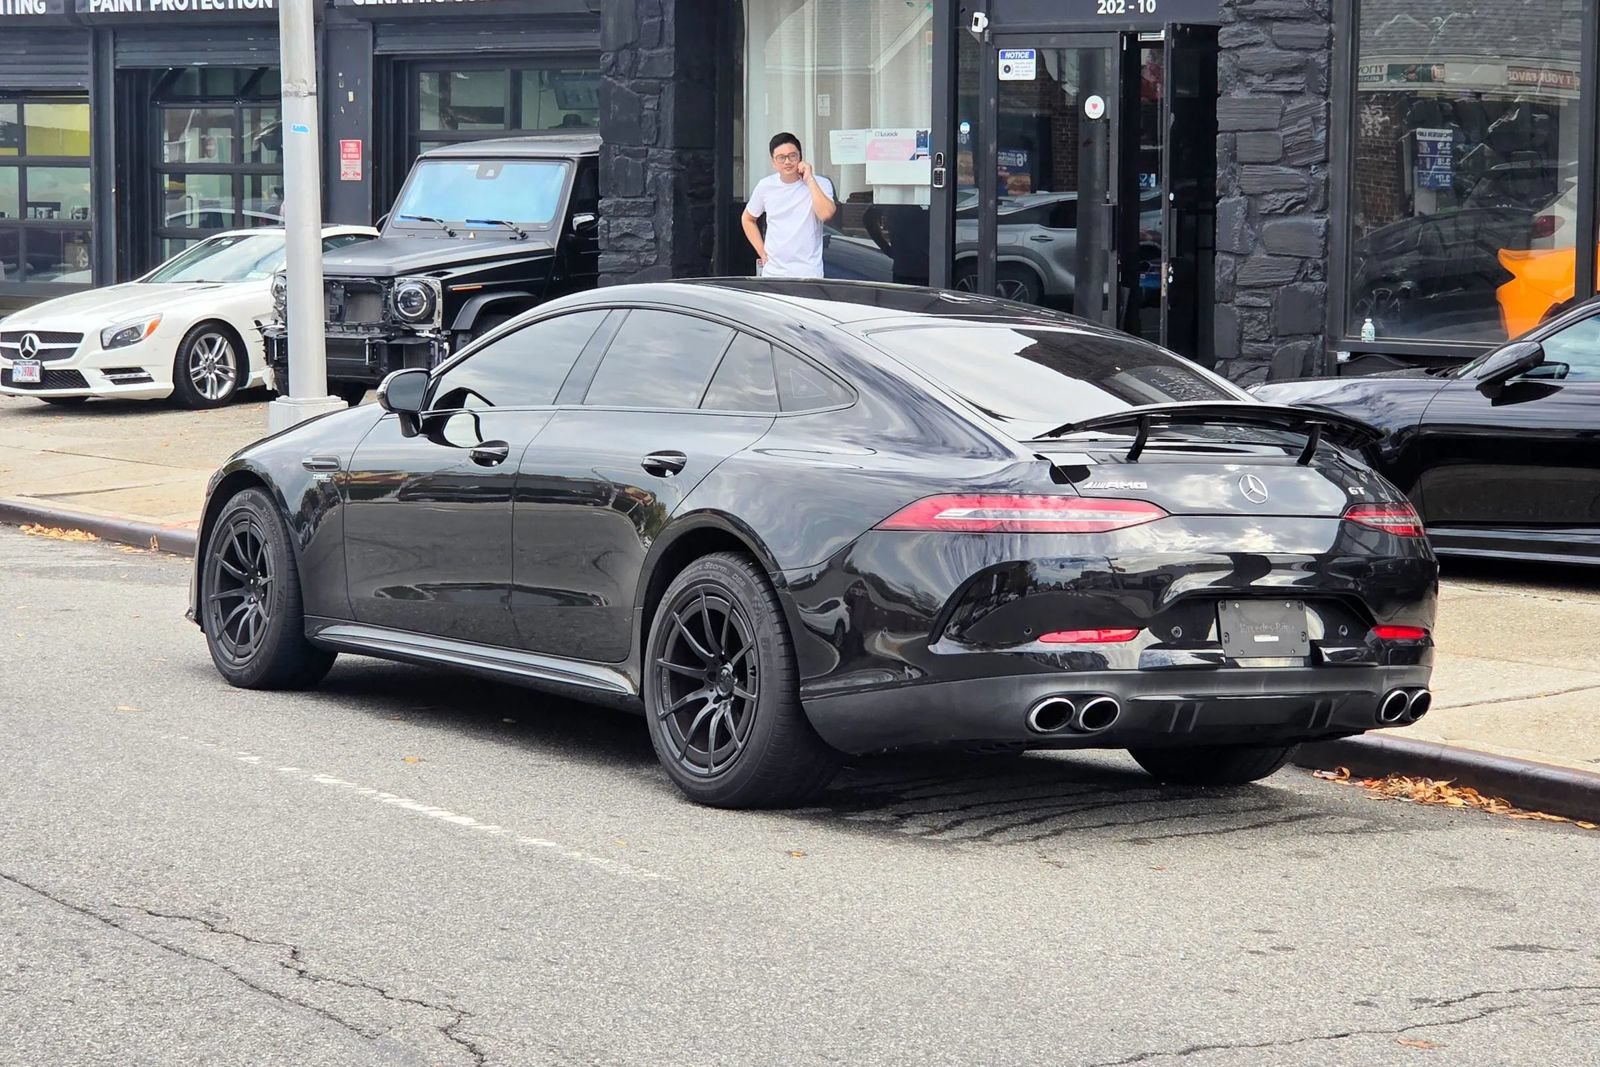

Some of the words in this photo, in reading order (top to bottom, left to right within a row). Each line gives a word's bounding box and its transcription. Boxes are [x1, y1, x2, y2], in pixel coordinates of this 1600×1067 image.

[89, 0, 142, 12] PAINT
[1097, 0, 1126, 14] 202
[1138, 0, 1157, 13] 10
[1004, 51, 1030, 59] NOTICE
[1103, 480, 1148, 489] AMG
